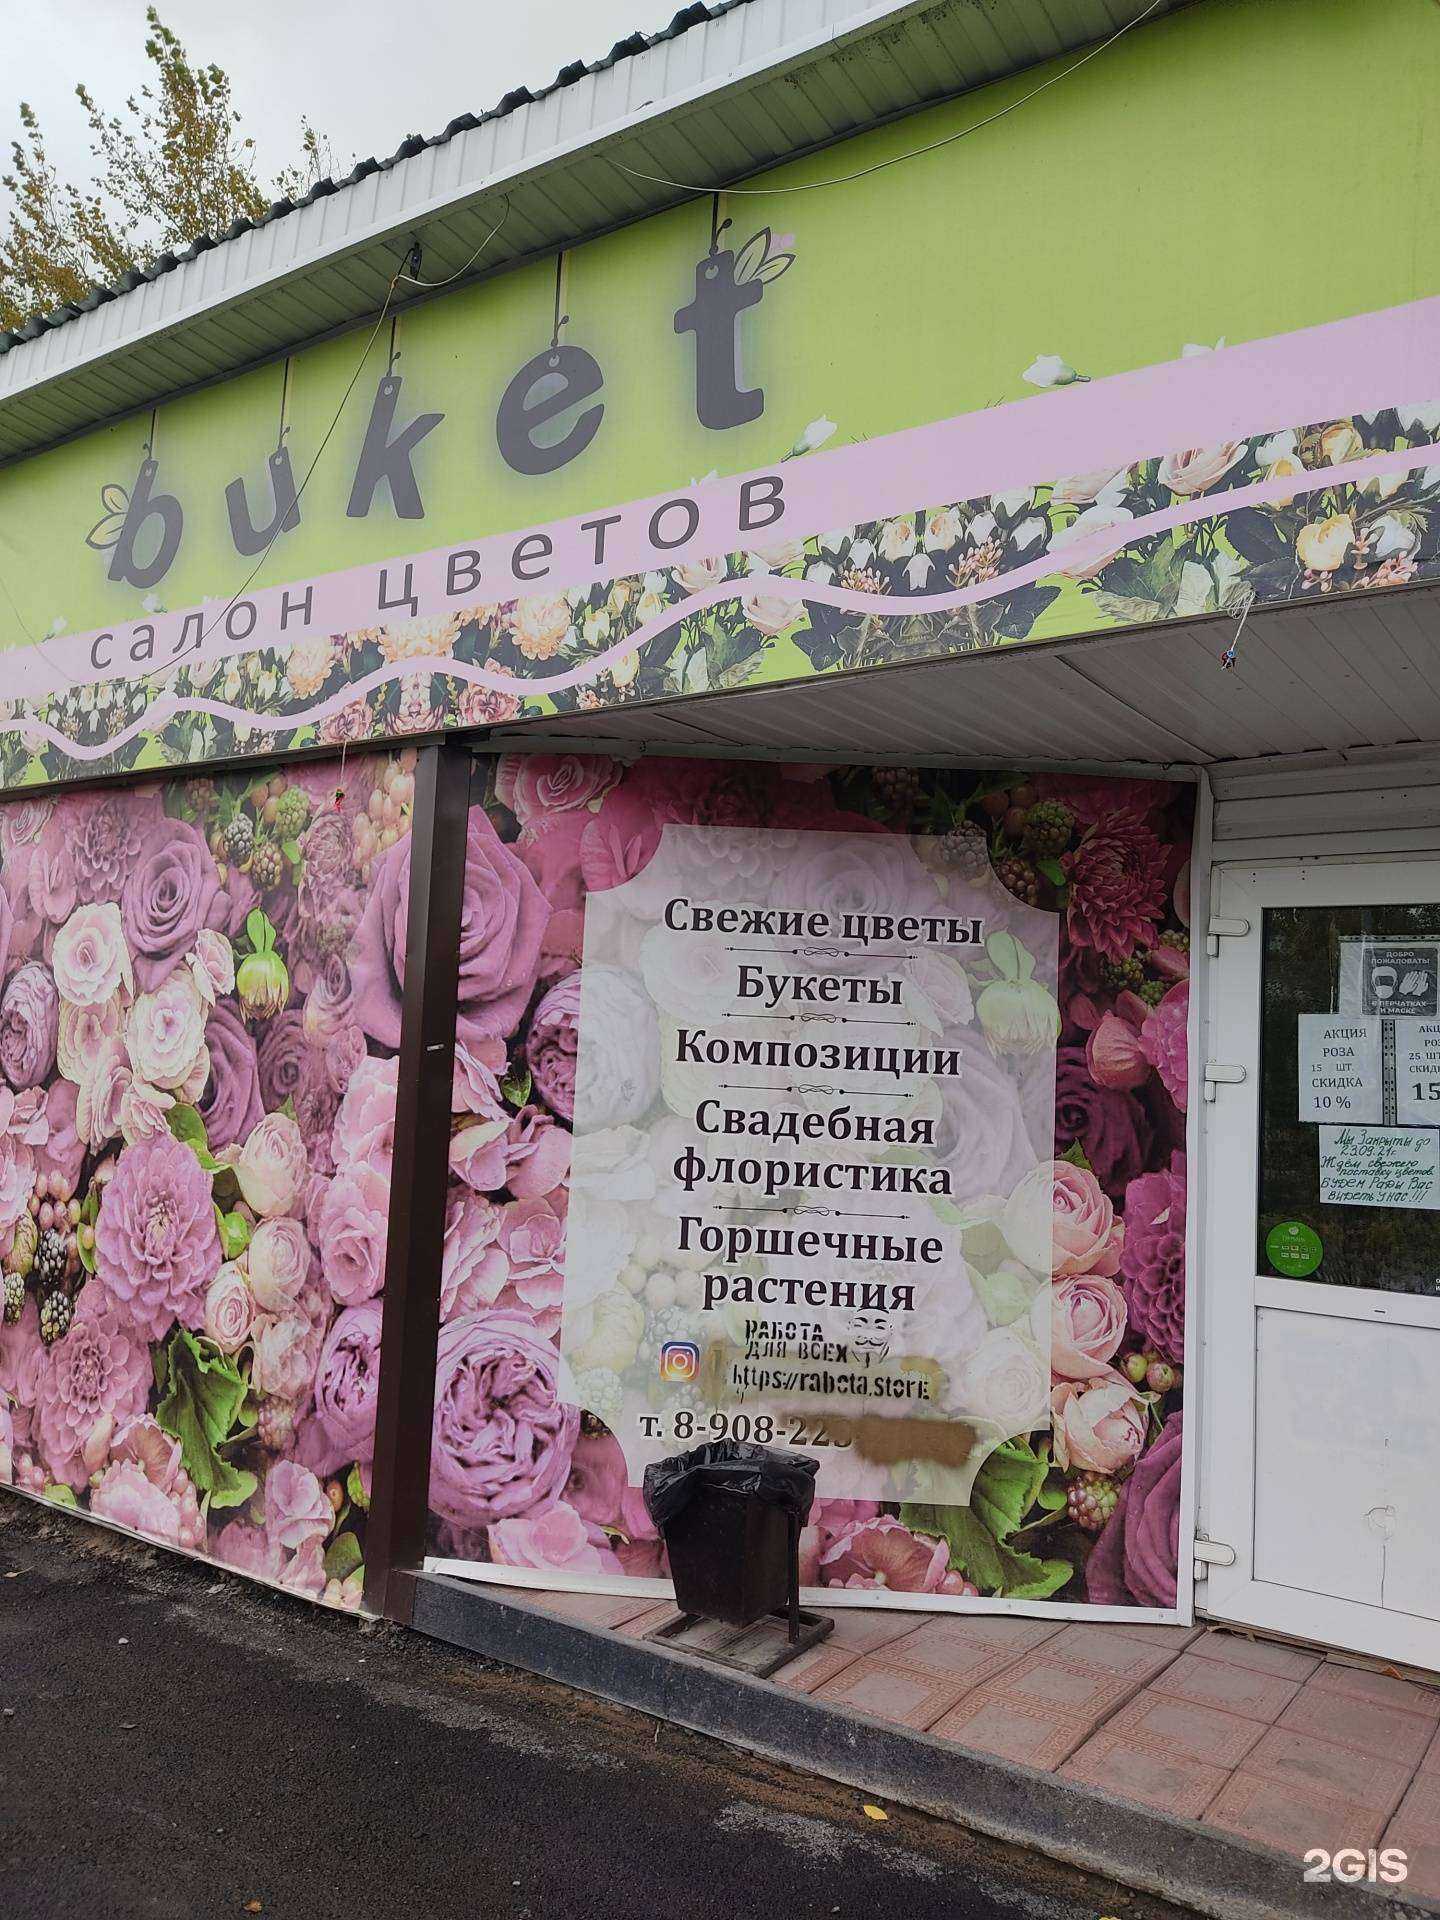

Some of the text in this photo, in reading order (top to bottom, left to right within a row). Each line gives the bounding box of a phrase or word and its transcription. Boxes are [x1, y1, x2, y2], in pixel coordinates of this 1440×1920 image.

[107, 249, 766, 590] buket
[89, 474, 788, 671] салон цветов
[664, 897, 984, 945] Свежие цветы
[737, 965, 903, 1007] Букеты
[676, 1028, 961, 1077] Композиции
[1322, 1046, 1355, 1058] РОЗА
[1323, 1028, 1368, 1040] АКЦИЯ
[1409, 1052, 1421, 1061] 25
[1311, 1078, 1363, 1090] СКИДКА
[1313, 1096, 1332, 1109] 10
[695, 1099, 935, 1145] Свадебная
[672, 1146, 953, 1196] флористика
[678, 1215, 944, 1265] Горшечные
[702, 1271, 915, 1312] растения
[744, 1319, 824, 1343] РАБОТА
[744, 1341, 848, 1363] ДЛЯ ВСЕХ
[673, 1411, 853, 1448] 8-908-22
